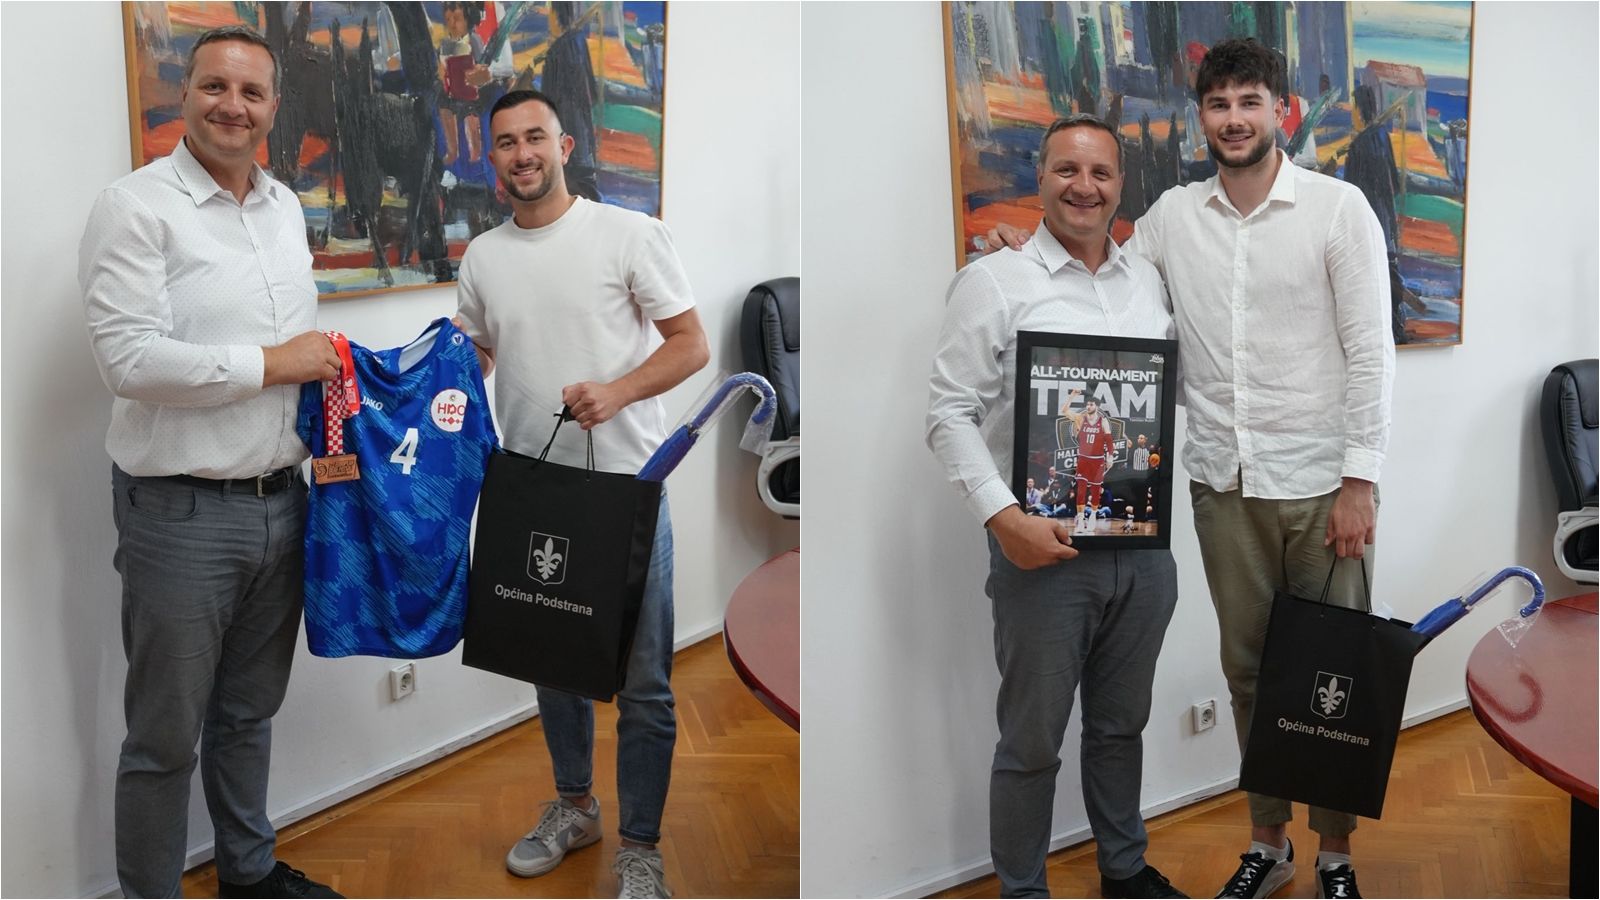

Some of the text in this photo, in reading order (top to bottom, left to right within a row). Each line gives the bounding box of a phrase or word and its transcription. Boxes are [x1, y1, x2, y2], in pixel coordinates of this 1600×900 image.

[1031, 365, 1158, 383] ALL-TOURNAMENT
[360, 395, 383, 411] JAKO
[1030, 379, 1157, 419] TEAM
[390, 428, 419, 475] 4
[1086, 434, 1096, 444] 10
[495, 584, 593, 616] Općina Podstrana
[1277, 718, 1370, 746] Općina Podstrana
